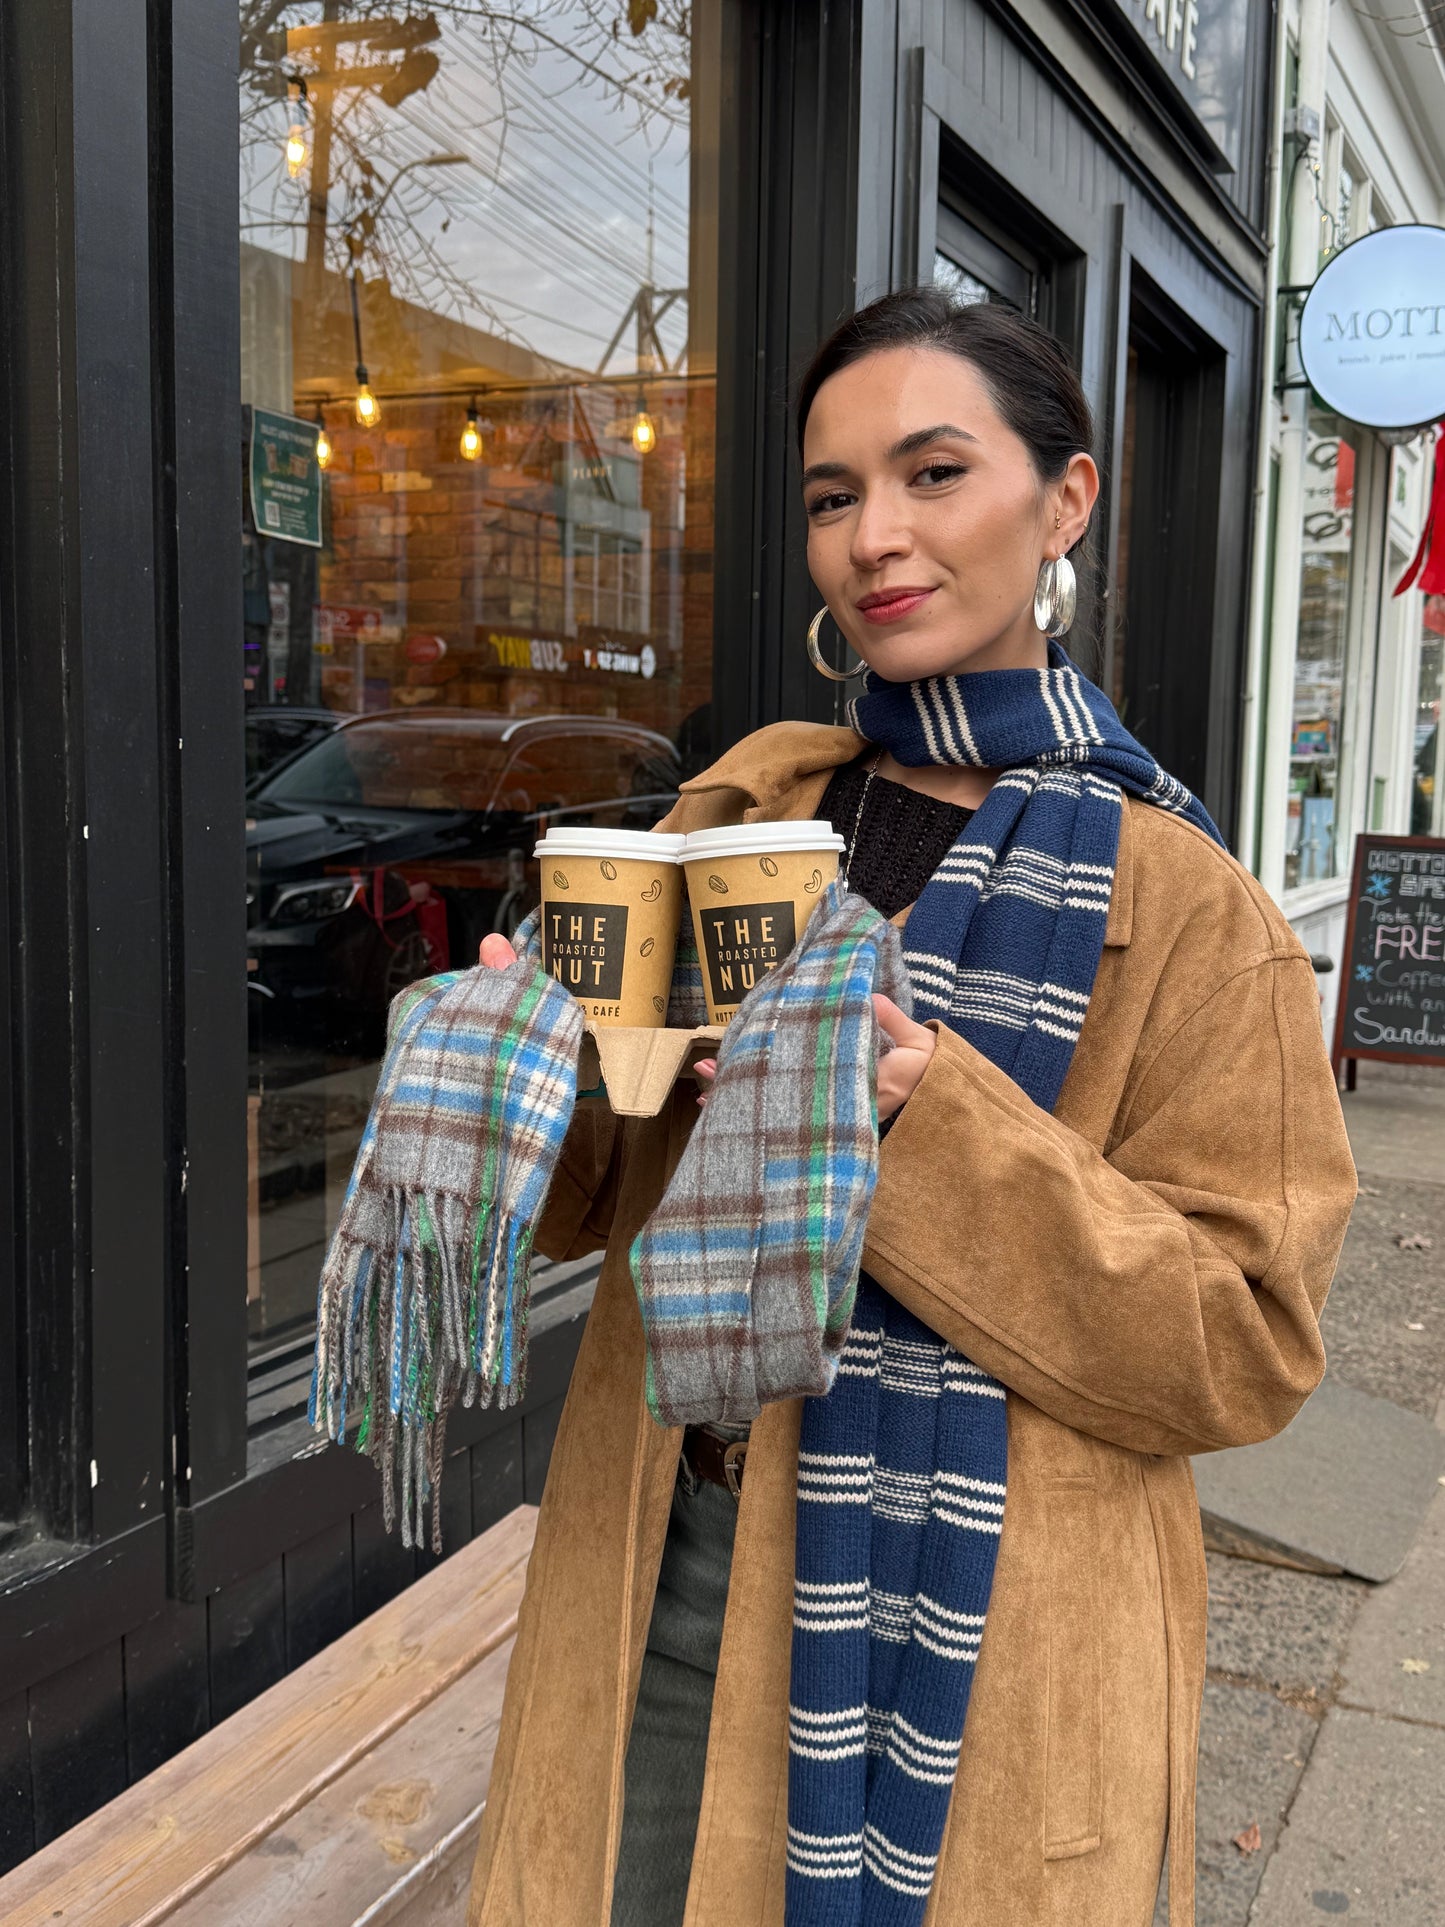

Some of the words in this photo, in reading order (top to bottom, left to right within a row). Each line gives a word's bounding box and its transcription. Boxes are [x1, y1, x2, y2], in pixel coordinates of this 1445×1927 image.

[552, 914, 606, 942] THE
[713, 916, 775, 947] THE
[552, 943, 606, 957] ROASTED
[717, 946, 777, 962] ROASTED
[1374, 925, 1445, 961] FRE
[552, 958, 605, 986] NUT
[1376, 959, 1445, 991] Coffe
[593, 1004, 620, 1017] CAFÉ
[1366, 990, 1415, 1008] with
[715, 1011, 738, 1023] NOTT
